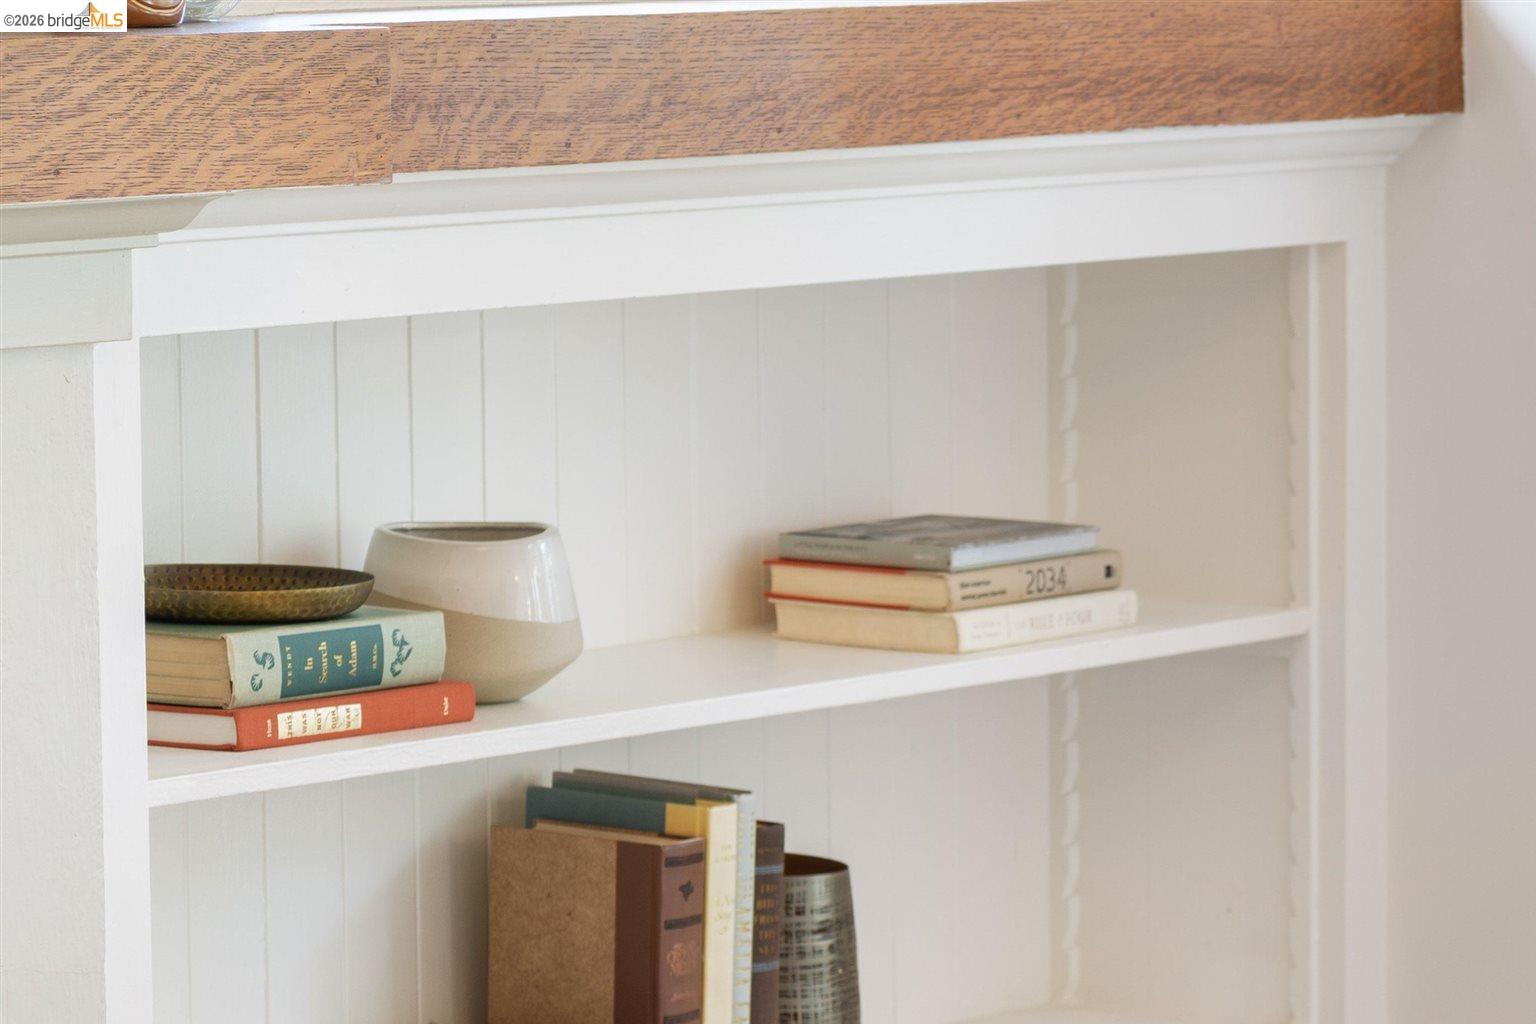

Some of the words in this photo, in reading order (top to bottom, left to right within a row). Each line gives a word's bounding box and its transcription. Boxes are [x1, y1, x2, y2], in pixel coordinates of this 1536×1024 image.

[1026, 566, 1067, 596] 2034
[304, 656, 314, 671] In
[319, 641, 329, 684] Search
[333, 653, 343, 668] of
[348, 640, 358, 677] Adam
